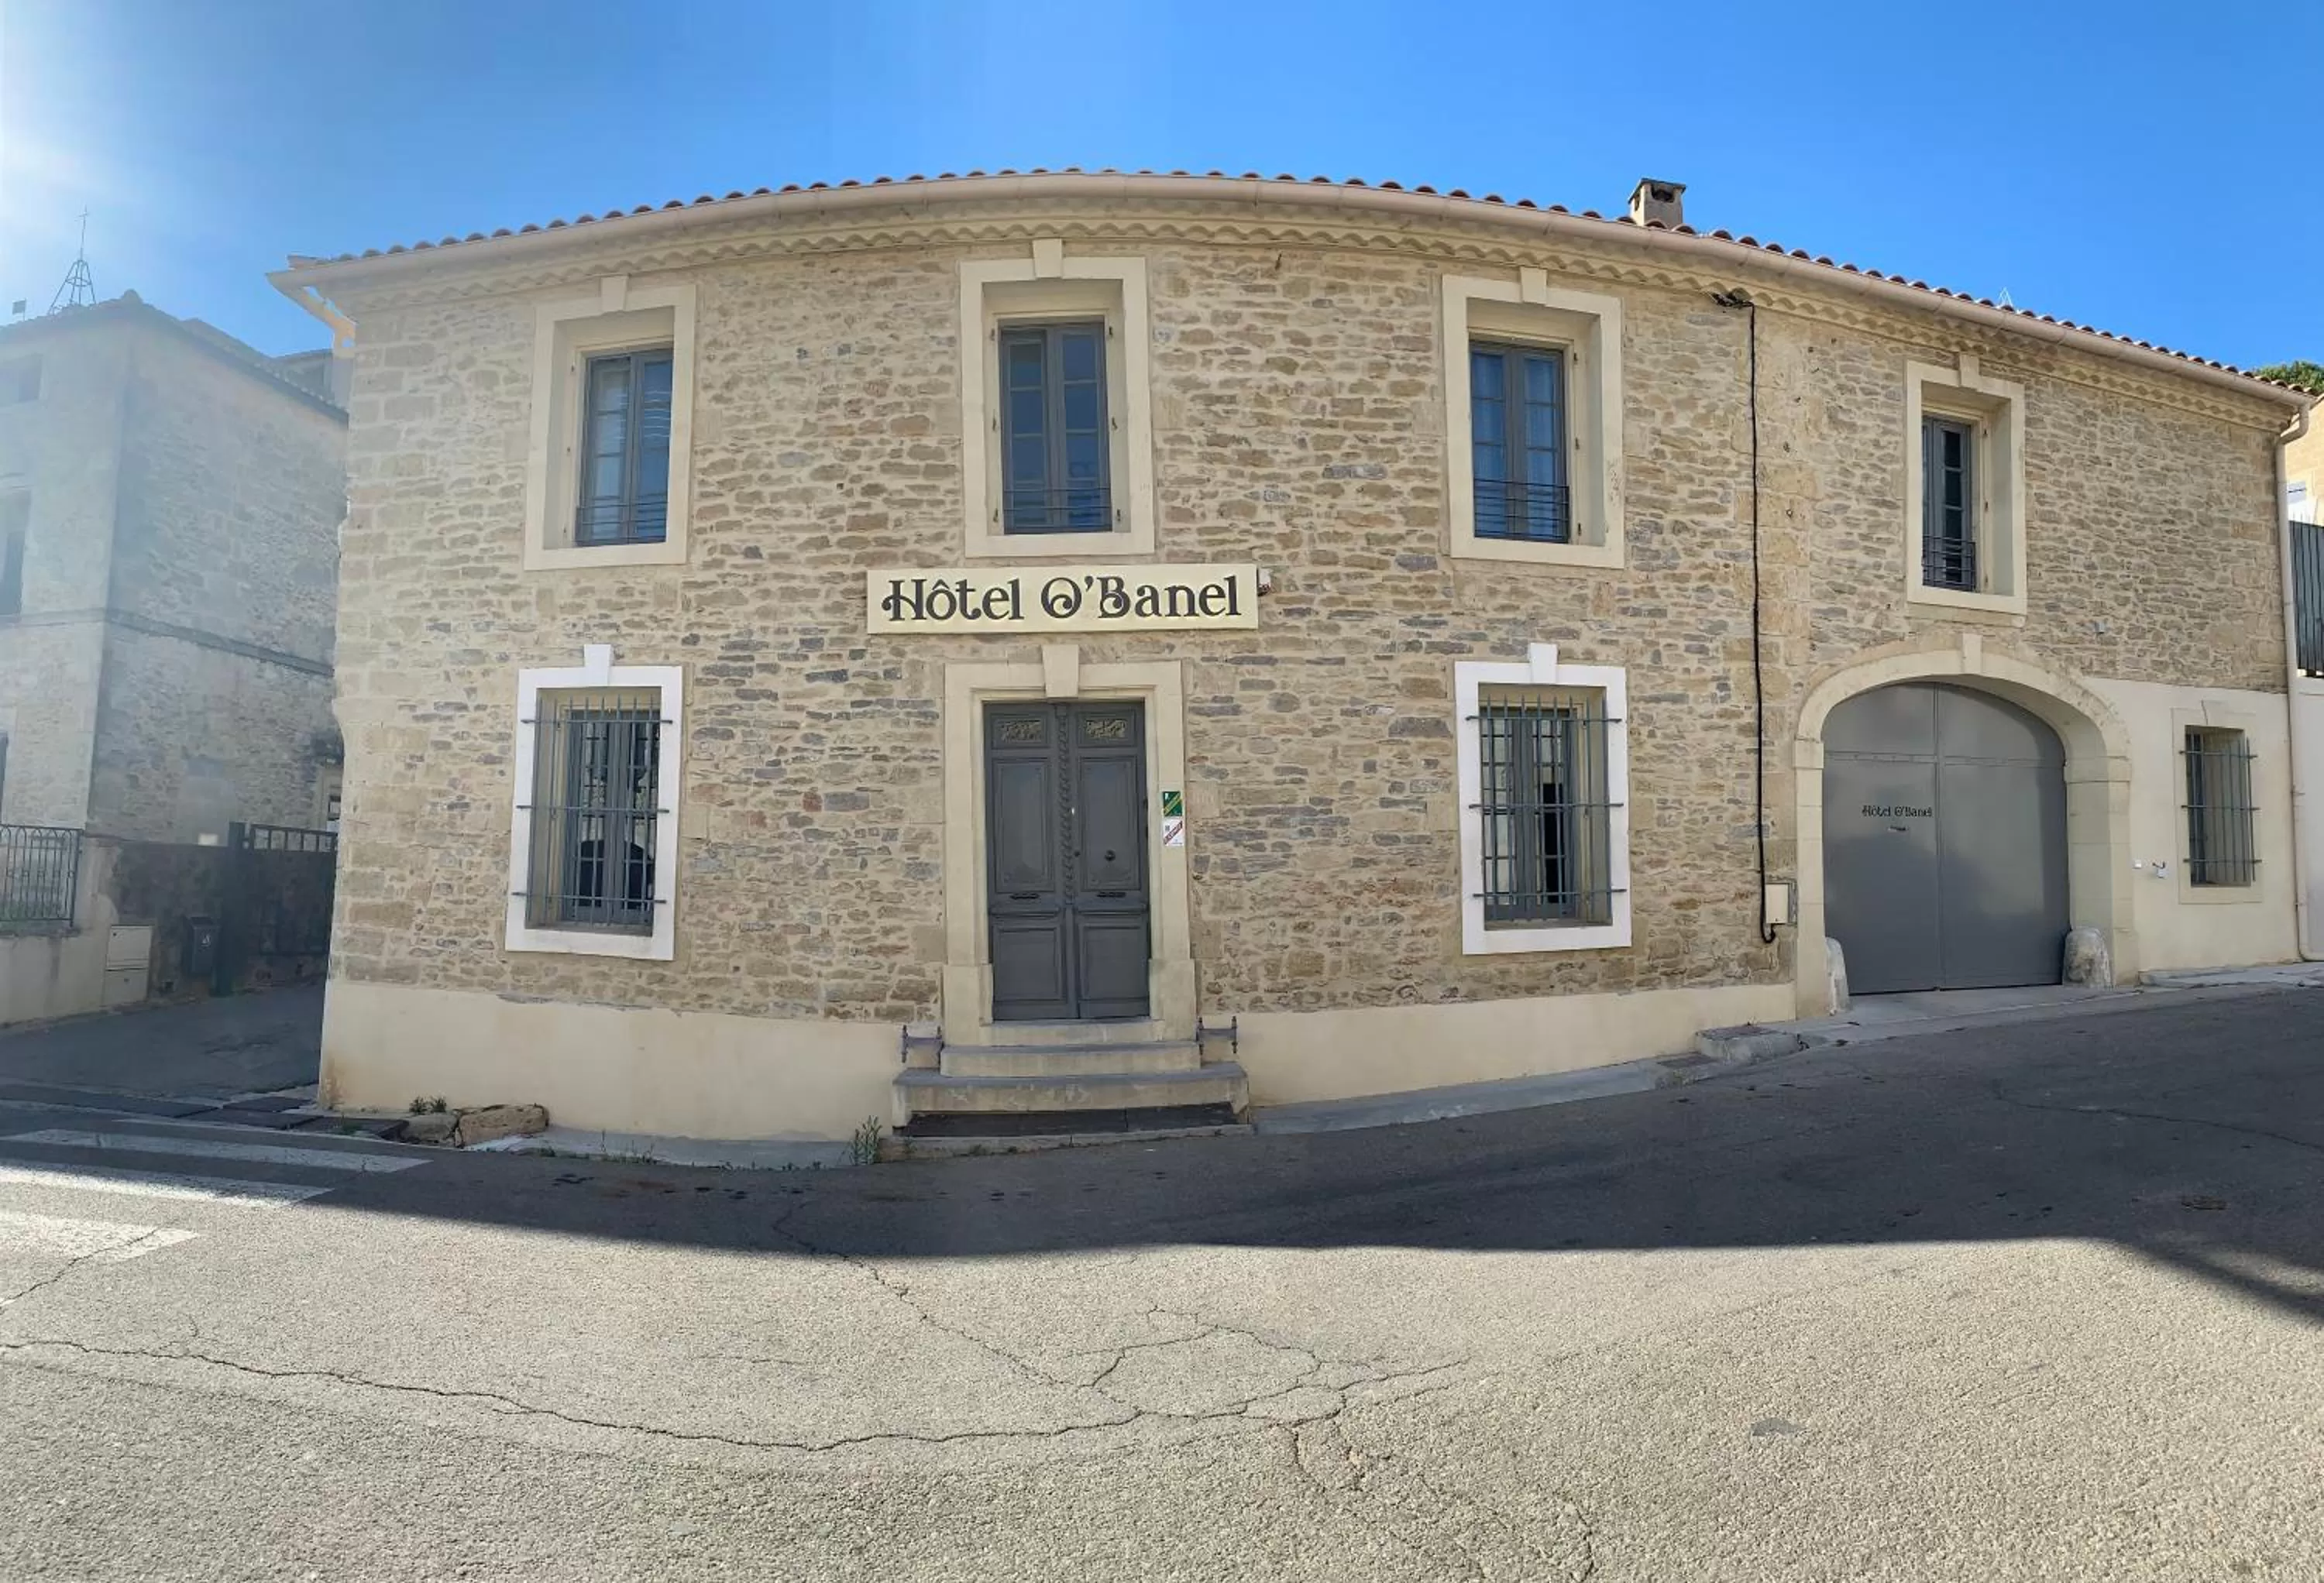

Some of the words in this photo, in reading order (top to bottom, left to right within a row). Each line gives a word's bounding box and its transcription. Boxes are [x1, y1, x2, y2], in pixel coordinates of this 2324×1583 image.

[881, 578, 1025, 620] Hôtel
[1040, 575, 1242, 619] O'Banel
[1862, 805, 1891, 817] Hôtel
